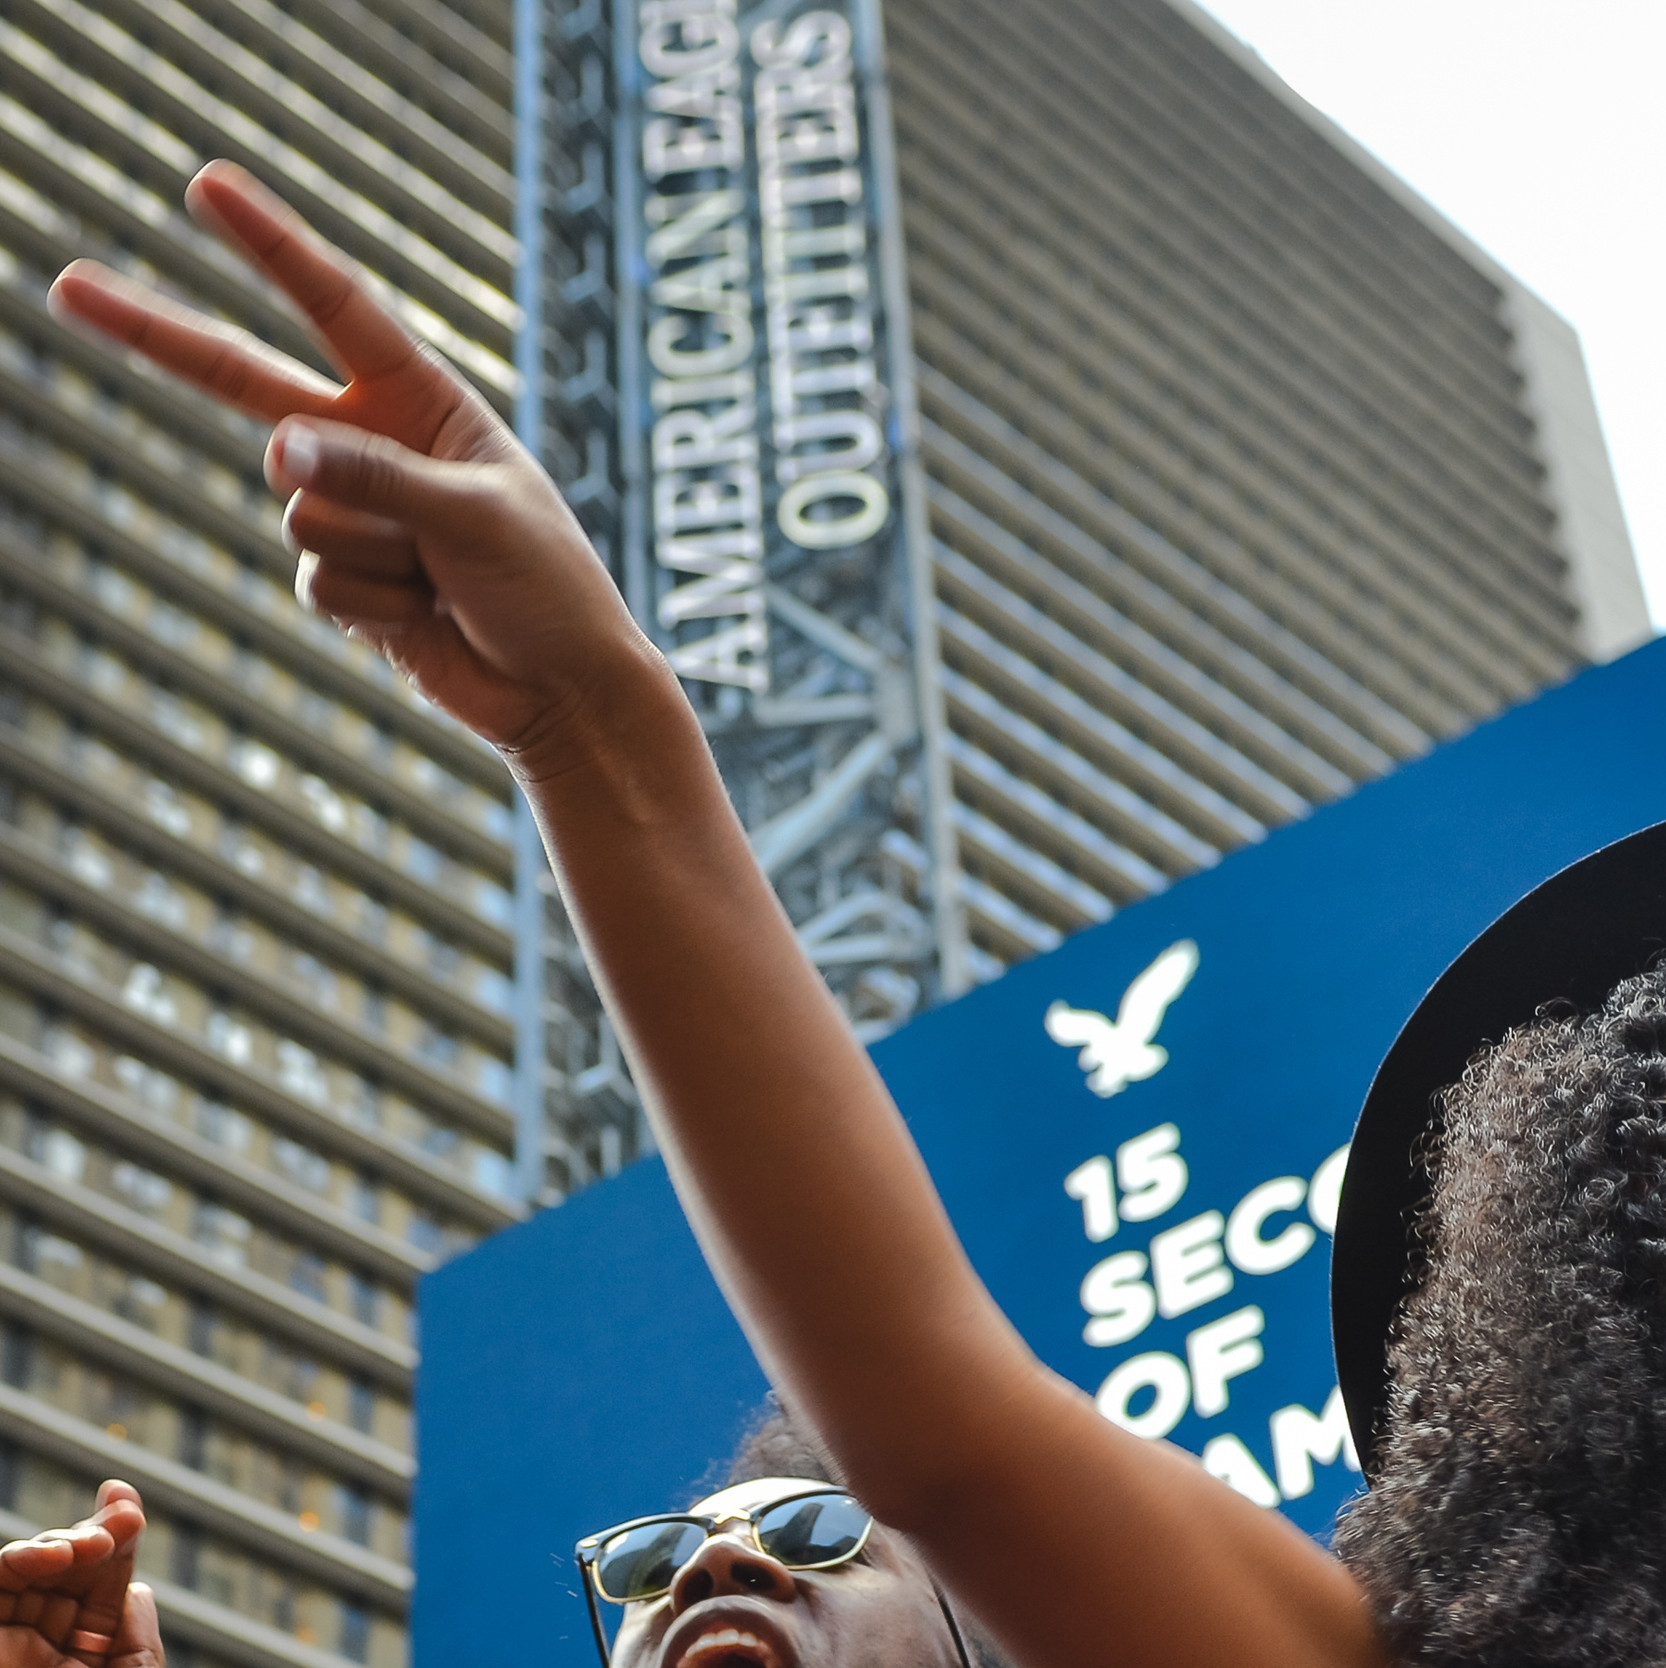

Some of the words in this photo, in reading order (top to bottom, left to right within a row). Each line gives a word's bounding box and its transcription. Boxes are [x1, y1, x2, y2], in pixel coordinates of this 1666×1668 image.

[749, 10, 889, 549] OUTFITTERS
[645, 187, 769, 694] AMERICAN
[1064, 1122, 1189, 1243] 15
[1096, 1304, 1265, 1440] OF
